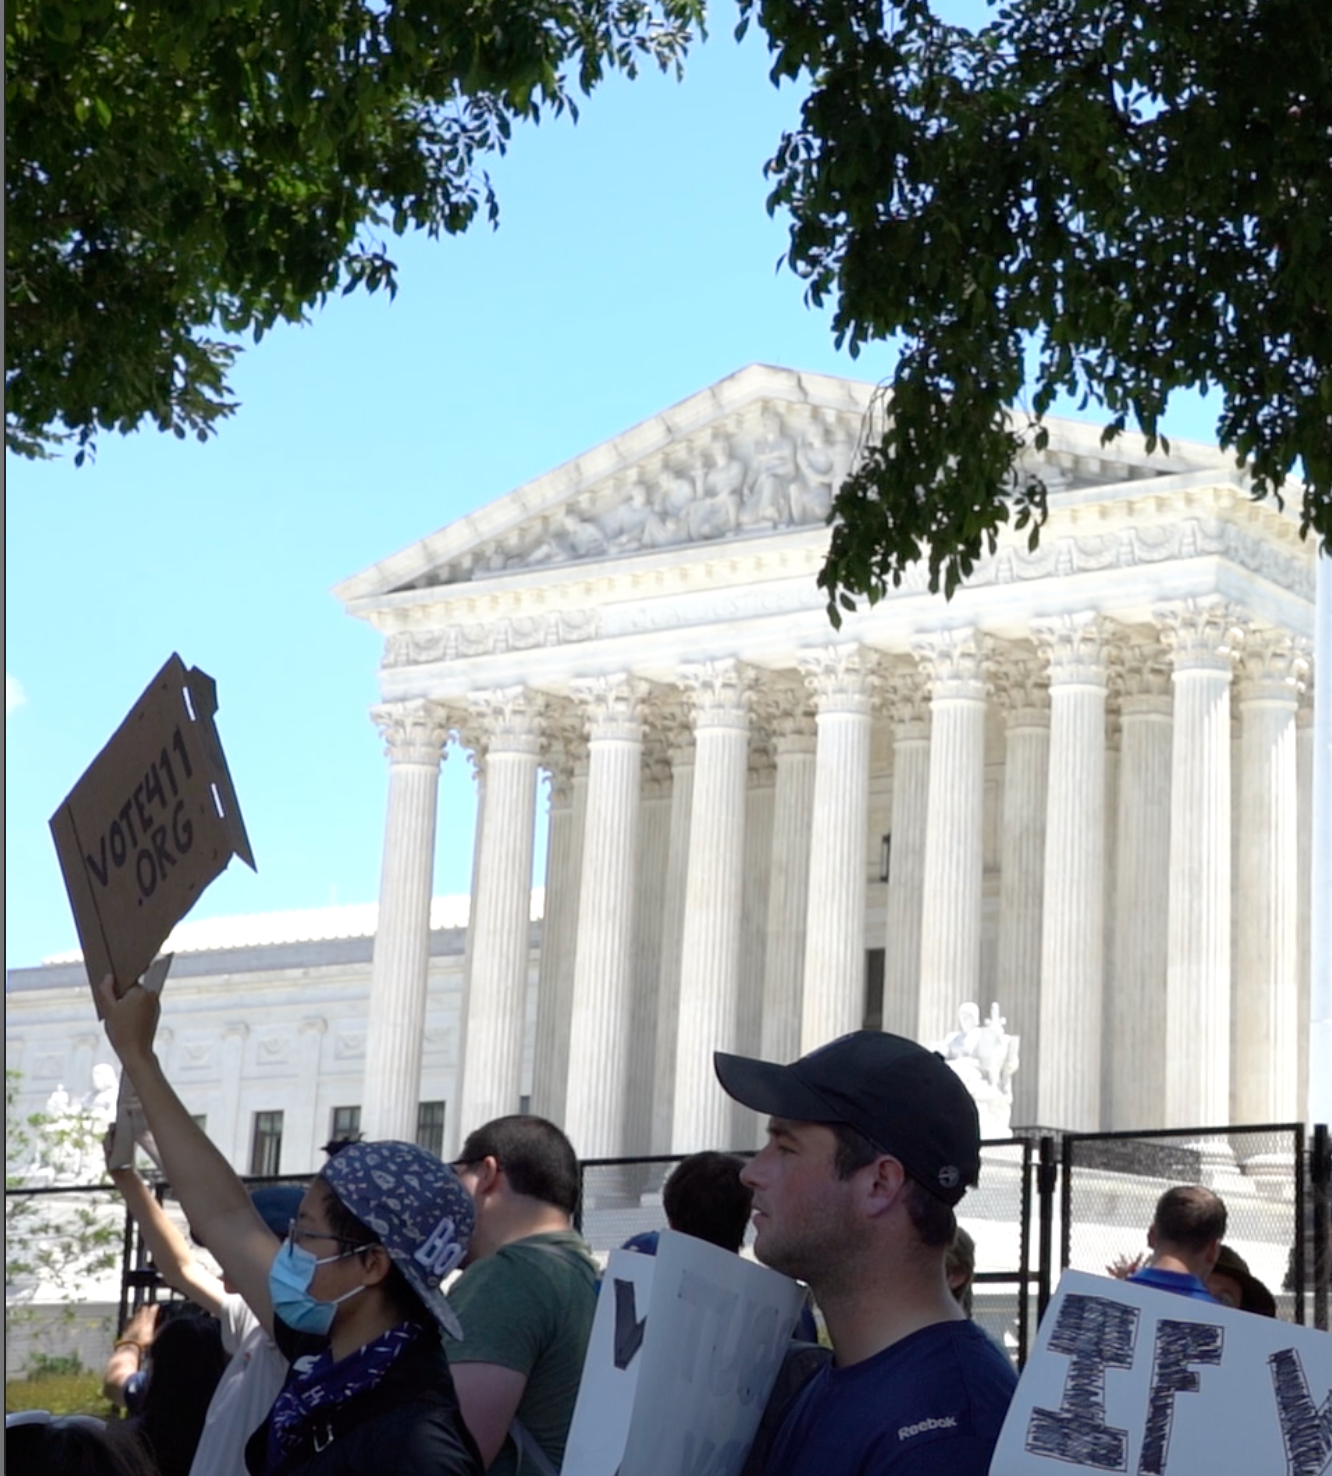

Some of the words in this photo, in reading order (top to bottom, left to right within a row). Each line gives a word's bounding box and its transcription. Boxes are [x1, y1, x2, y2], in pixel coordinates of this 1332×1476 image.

[86, 725, 193, 887] VOTE411
[137, 799, 194, 907] .ORG
[898, 1416, 957, 1441] Reebok
[1025, 1293, 1225, 1476] IF
